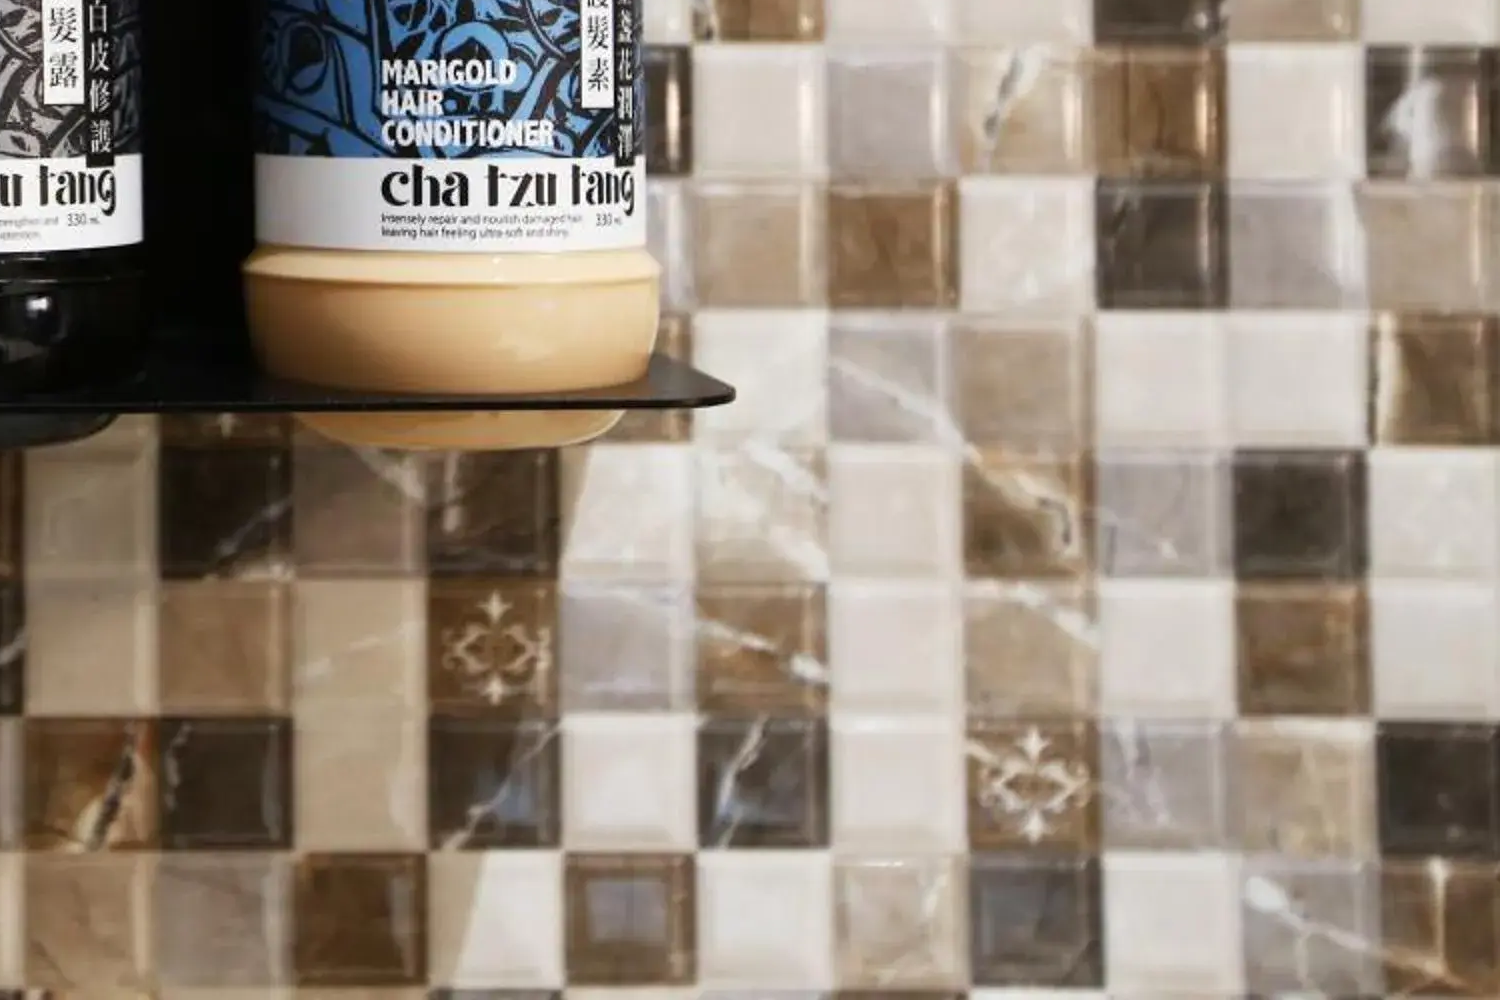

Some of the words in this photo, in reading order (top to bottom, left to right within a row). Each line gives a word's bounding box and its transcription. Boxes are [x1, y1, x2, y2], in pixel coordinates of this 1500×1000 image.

[381, 59, 517, 86] MARIGOLD
[381, 90, 444, 116] HAIR
[381, 119, 554, 147] CONDITIONER
[39, 165, 116, 216] tang
[381, 165, 469, 207] cha
[484, 165, 556, 208] tzu
[572, 164, 634, 216] tang
[67, 213, 86, 227] 330
[460, 213, 480, 224] and
[596, 213, 612, 226] 330
